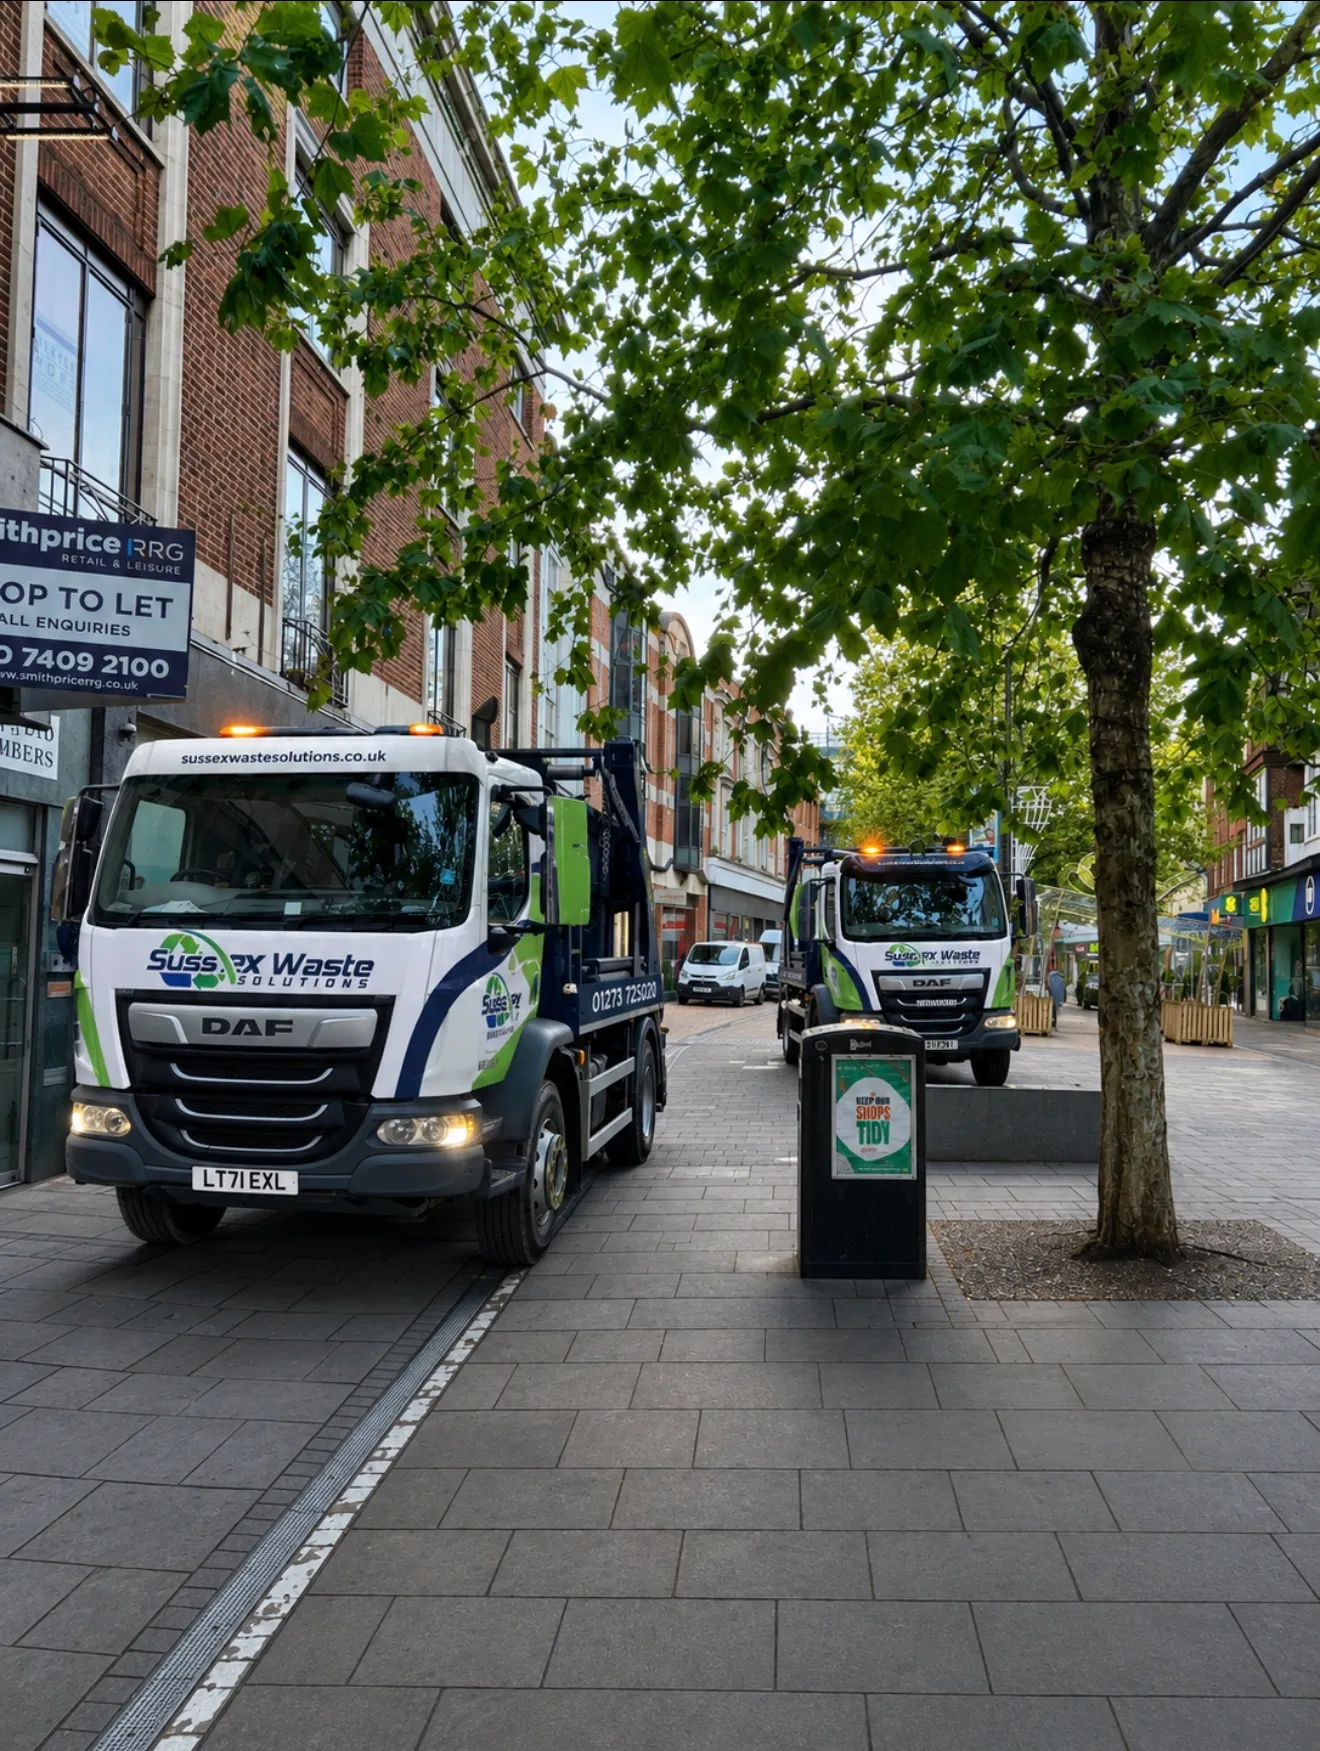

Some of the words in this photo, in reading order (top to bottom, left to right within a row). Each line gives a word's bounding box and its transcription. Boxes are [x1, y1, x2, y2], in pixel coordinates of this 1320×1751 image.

[62, 553, 106, 567] RETAIL
[112, 560, 120, 568] &
[127, 562, 181, 576] LEISURE
[0, 581, 48, 606] OP
[58, 586, 104, 612] TO
[115, 592, 174, 619] LET
[0, 612, 30, 627] ALL
[36, 616, 131, 637] ENQUIRIES
[22, 647, 94, 672] 7409
[101, 654, 169, 679] 2100
[181, 750, 386, 764] sussexwastesolutions.co.uk
[147, 949, 266, 974] Sussex
[272, 953, 374, 978] Waste
[941, 949, 980, 961] Waste
[237, 975, 369, 989] SOLUTIONS
[912, 979, 952, 987] DAF
[592, 987, 623, 1013] 01273
[625, 981, 657, 1005] 725020
[202, 1018, 293, 1036] DAF
[856, 1096, 874, 1105] KEEP
[856, 1105, 891, 1120] SHOPS
[856, 1120, 890, 1145] TIDY
[203, 1169, 244, 1189] LT71
[249, 1172, 286, 1190] EXL
